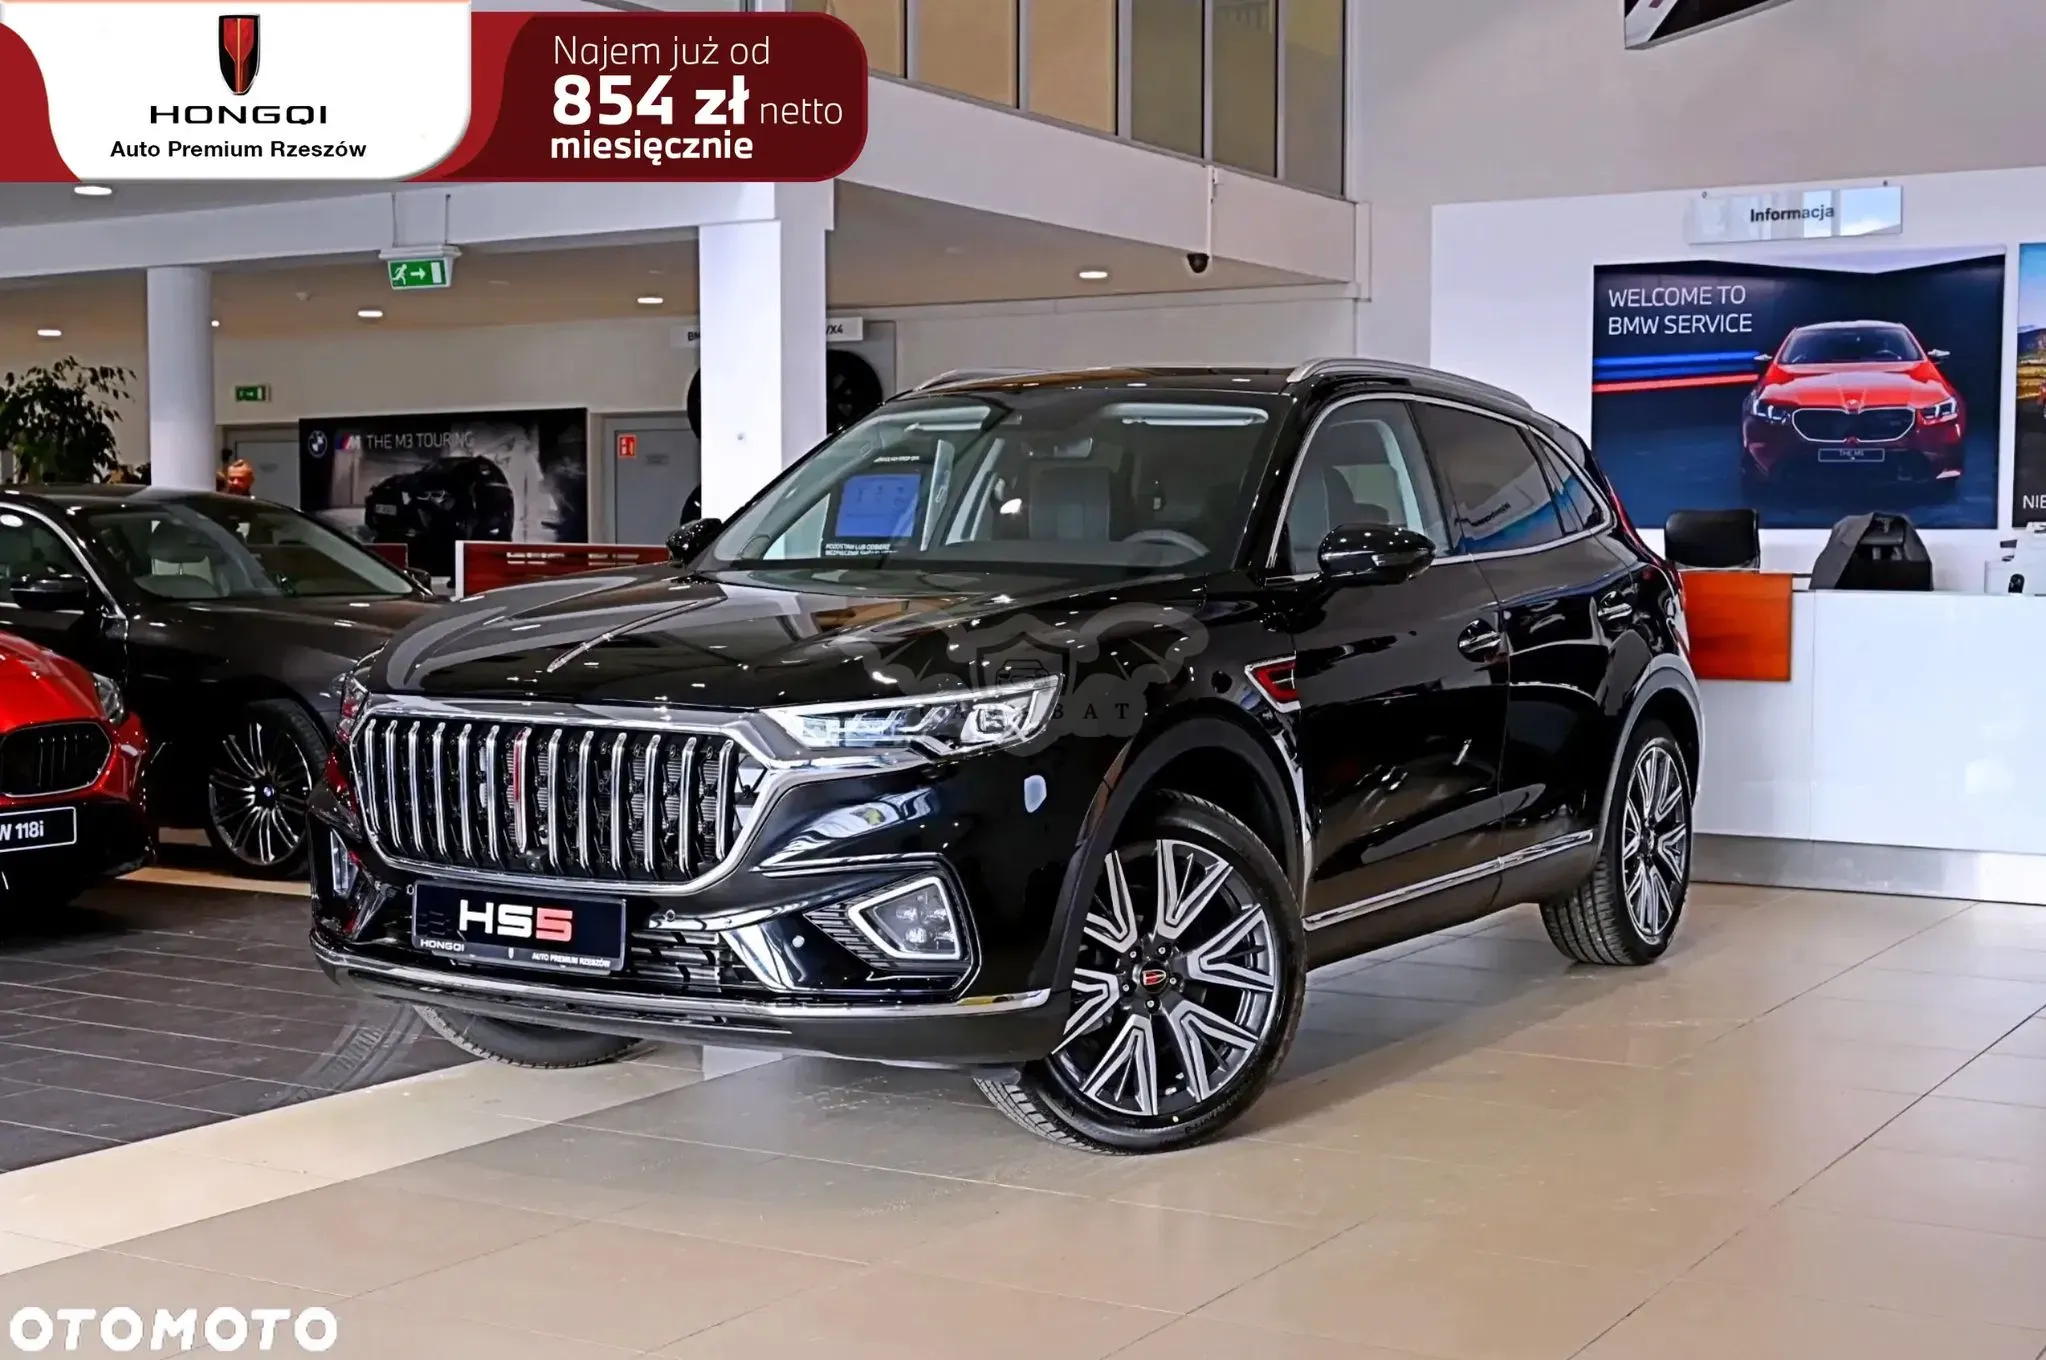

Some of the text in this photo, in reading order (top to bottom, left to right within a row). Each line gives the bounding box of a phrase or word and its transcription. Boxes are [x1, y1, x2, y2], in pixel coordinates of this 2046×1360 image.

[1750, 205, 1835, 223] Informacja
[1608, 284, 1746, 308] WELCOME TO
[1608, 313, 1753, 336] BMW SERVICE
[367, 433, 392, 450] THE
[395, 432, 413, 449] M3
[416, 431, 474, 449] TOURING
[15, 820, 44, 840] 118i
[458, 899, 574, 942] HS5
[531, 951, 549, 962] AUTO
[550, 954, 579, 965] PREMIUM
